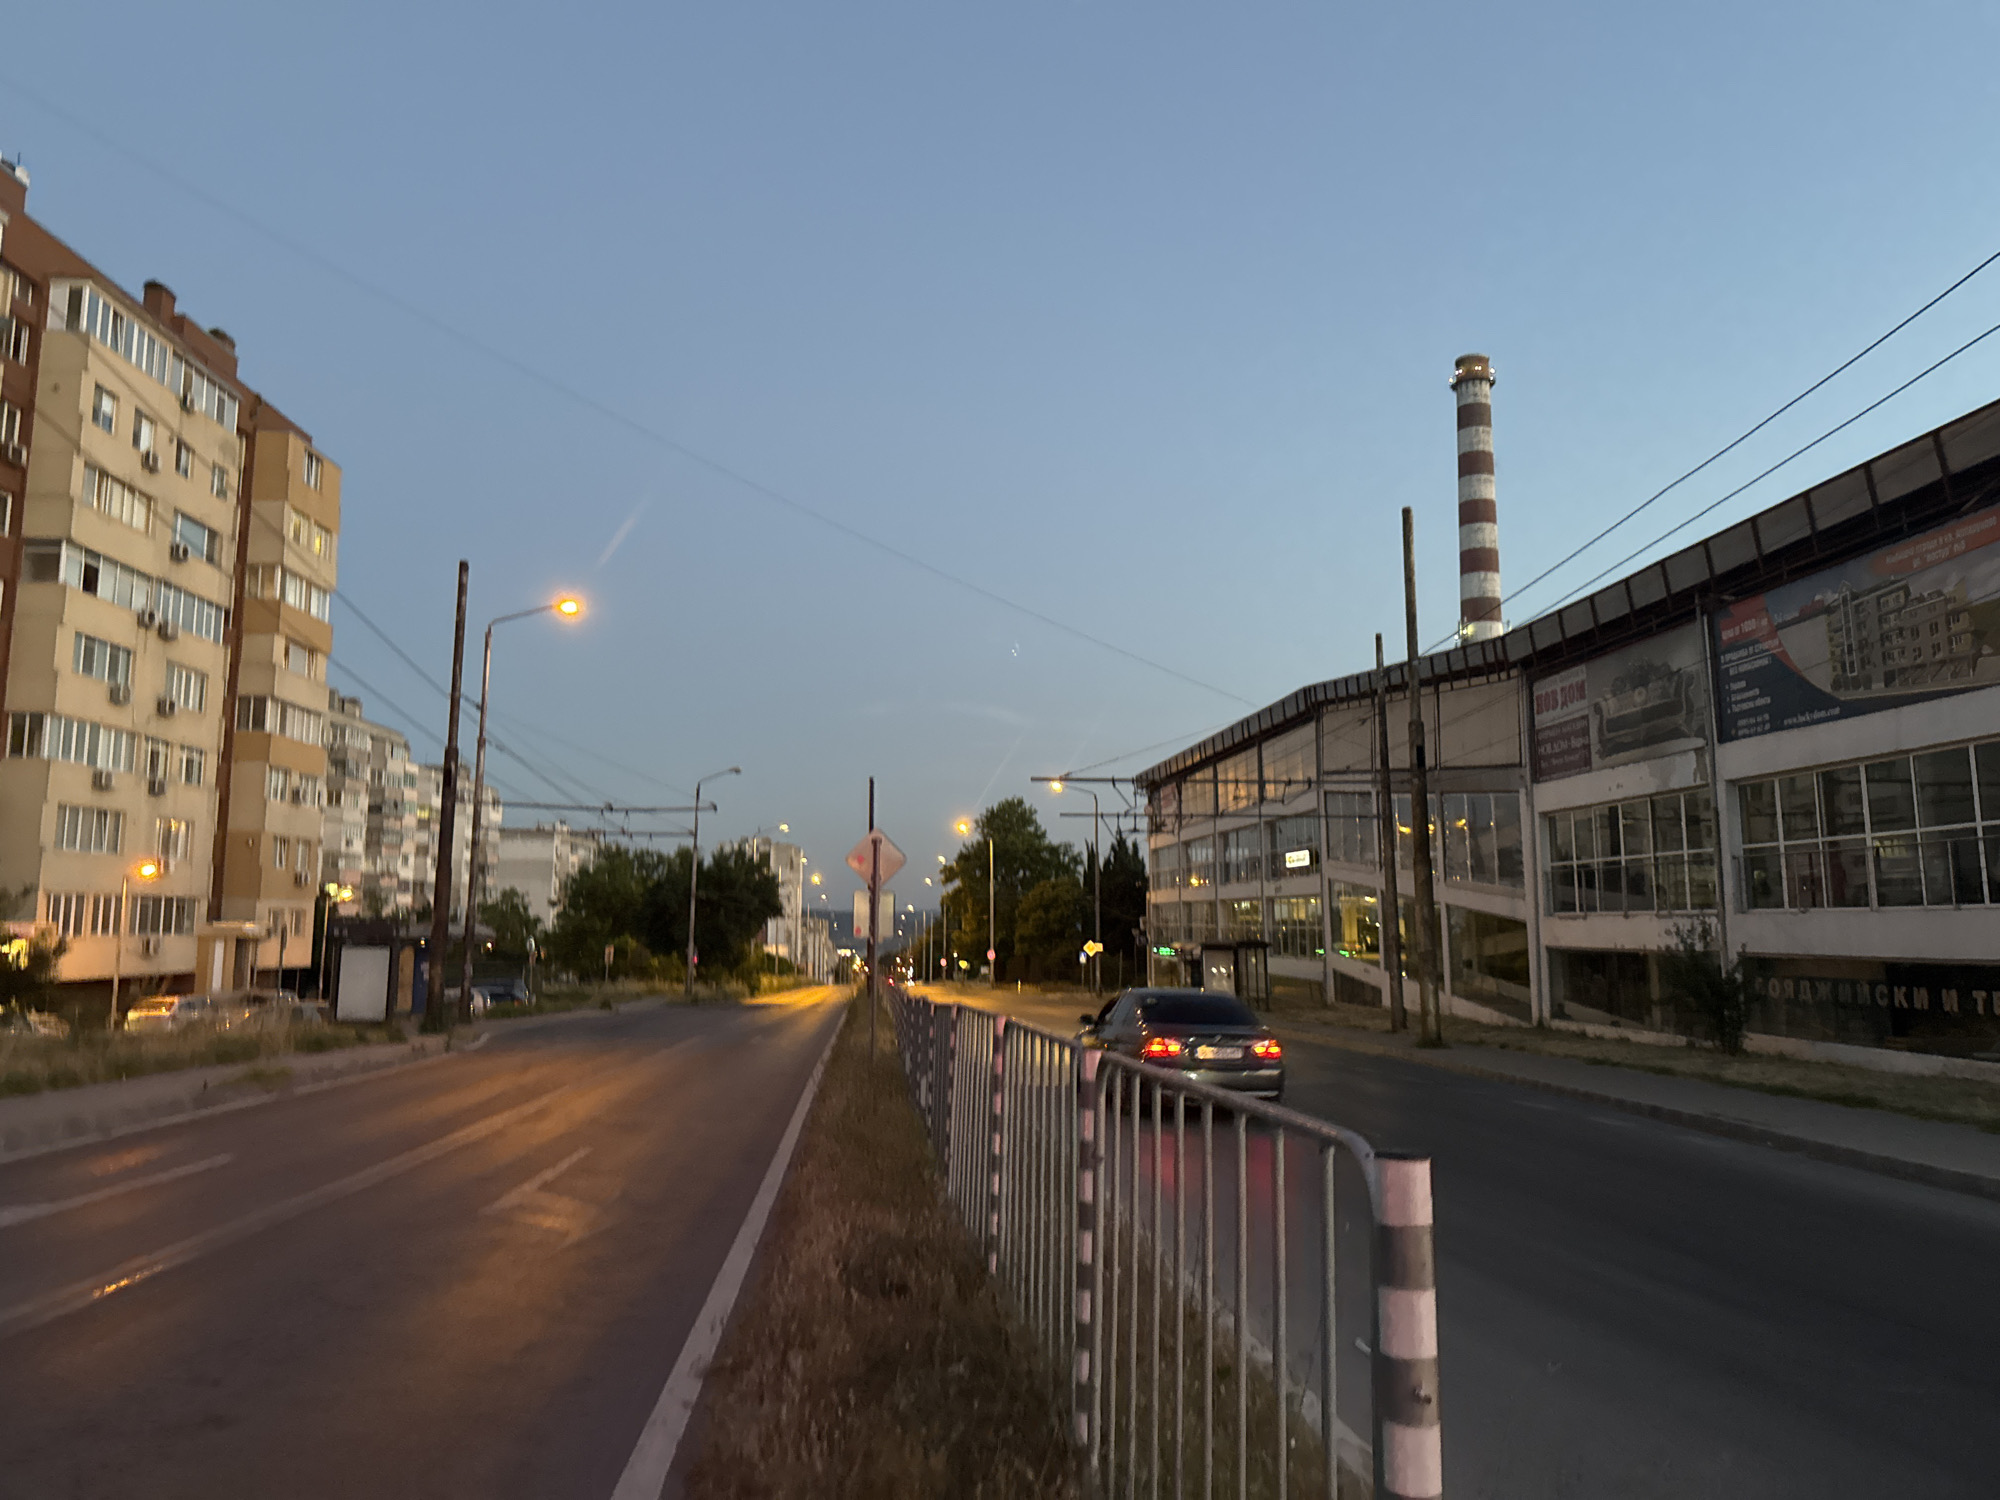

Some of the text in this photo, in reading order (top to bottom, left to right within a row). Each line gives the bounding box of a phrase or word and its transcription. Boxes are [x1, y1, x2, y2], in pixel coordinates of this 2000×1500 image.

[1535, 679, 1586, 715] НОВ ДОМ
[1941, 988, 1959, 1013] И
